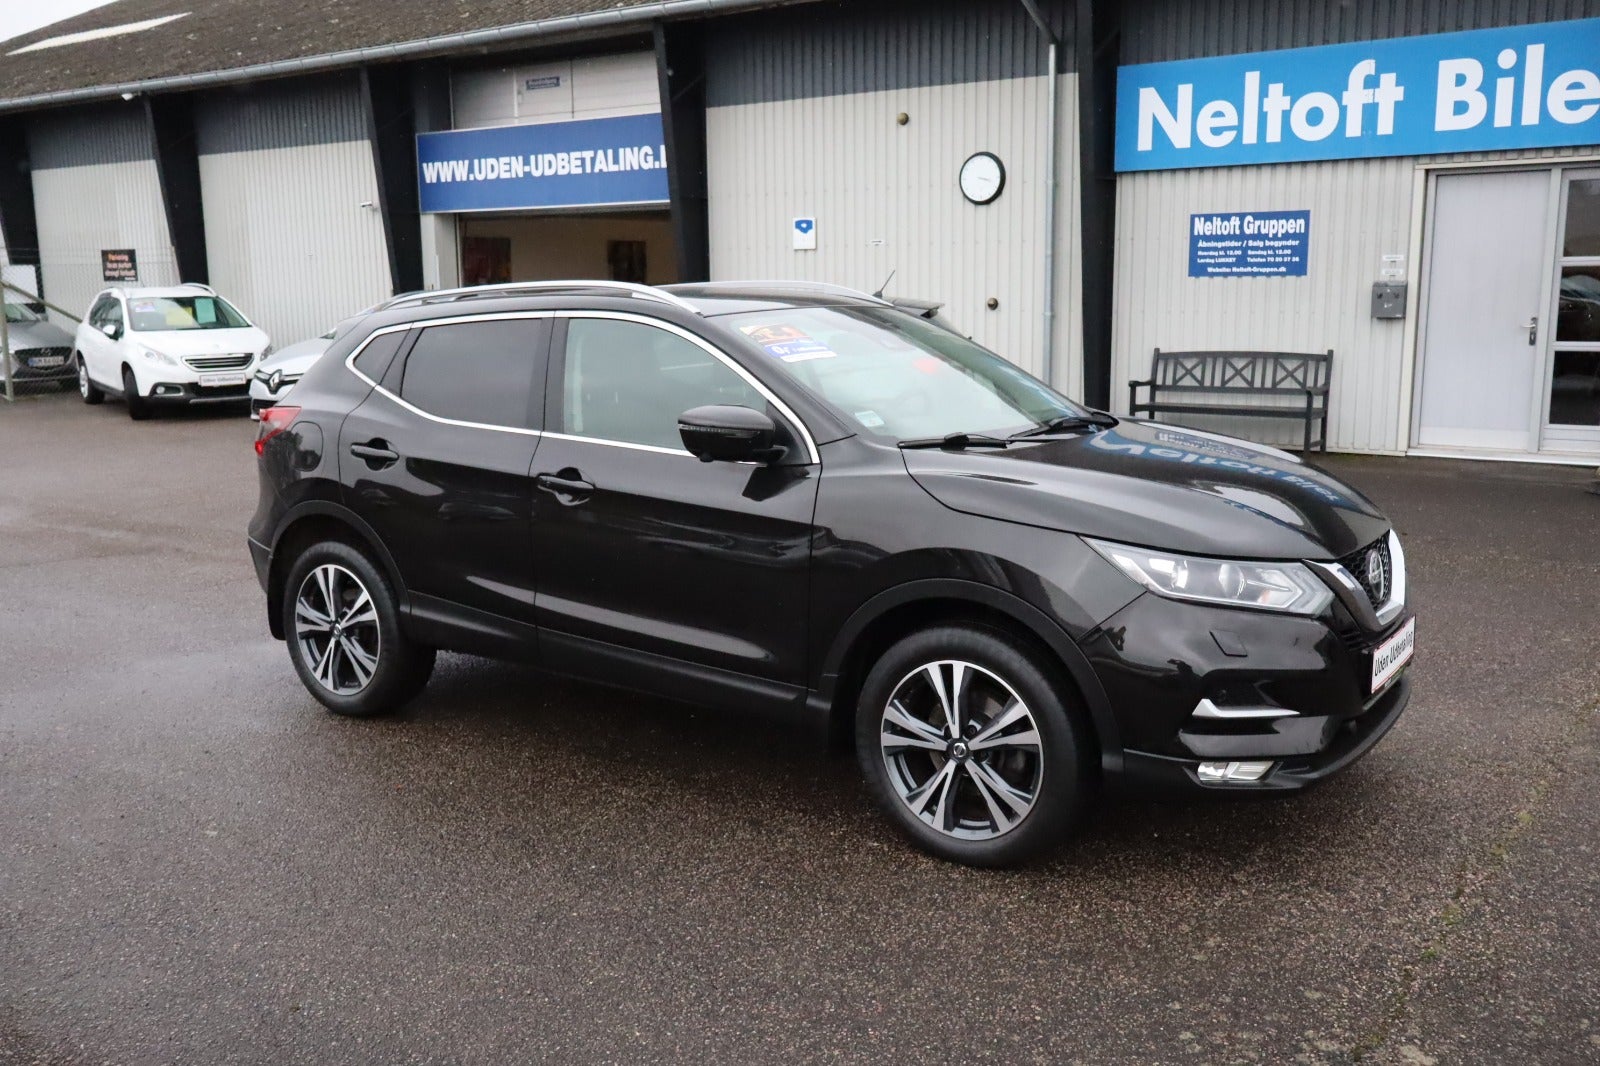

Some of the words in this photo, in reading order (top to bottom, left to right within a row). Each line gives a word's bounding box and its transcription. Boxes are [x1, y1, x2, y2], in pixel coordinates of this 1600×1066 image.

[1137, 59, 1404, 151] Neltoft
[1434, 43, 1600, 132] Bile
[1193, 215, 1240, 236] Neltoft
[1243, 215, 1305, 238] Gruppen
[1197, 239, 1242, 248] Åbningstider
[1265, 239, 1300, 247] begynder
[1375, 653, 1389, 677] Uden
